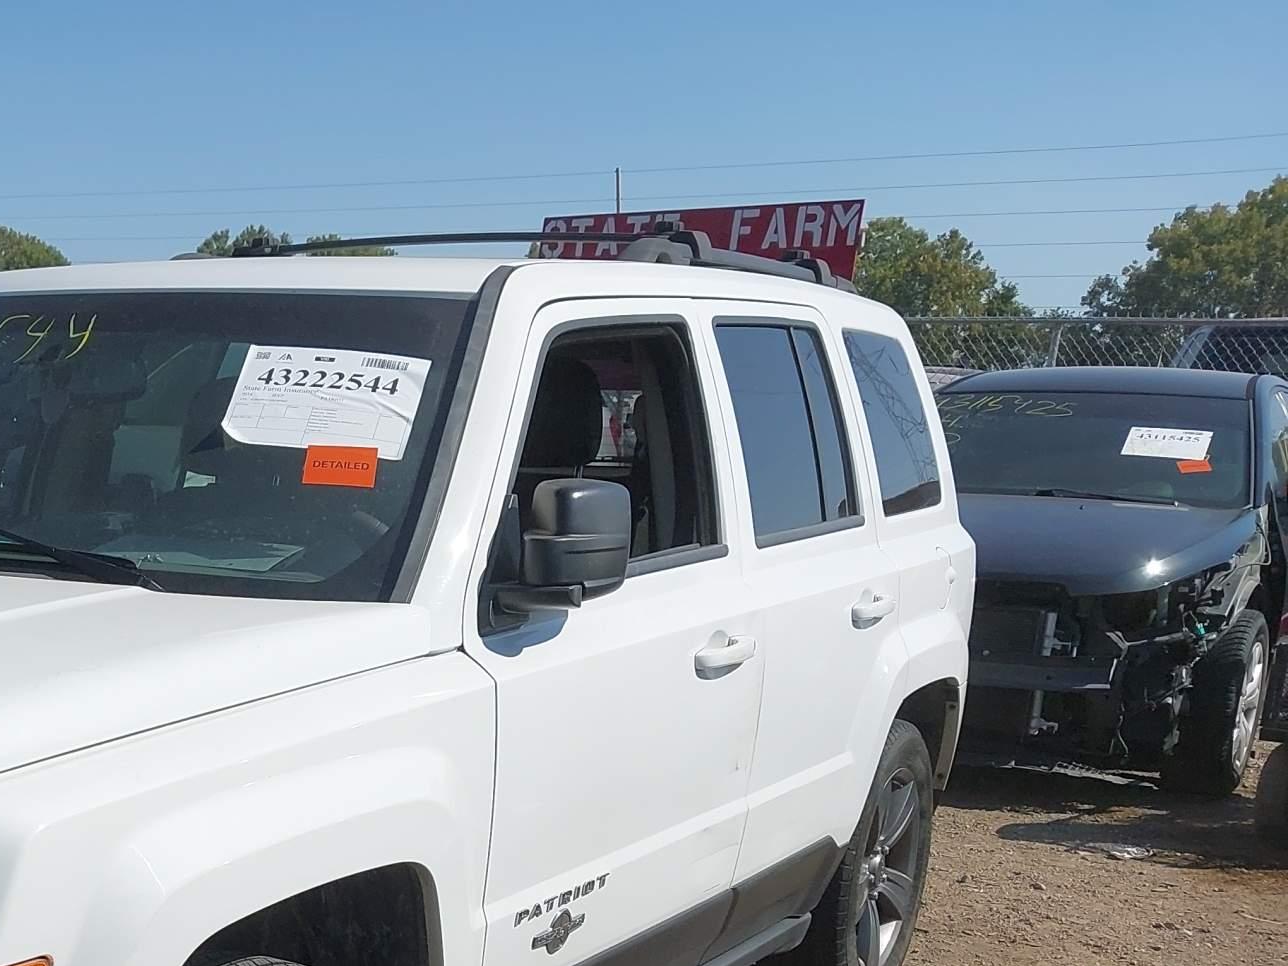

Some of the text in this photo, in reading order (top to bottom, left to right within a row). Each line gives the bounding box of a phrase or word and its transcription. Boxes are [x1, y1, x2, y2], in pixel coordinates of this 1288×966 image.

[728, 202, 863, 250] FARM
[257, 367, 400, 395] 43222544
[312, 460, 370, 471] DETAILED
[513, 872, 611, 929] PATRIOT
